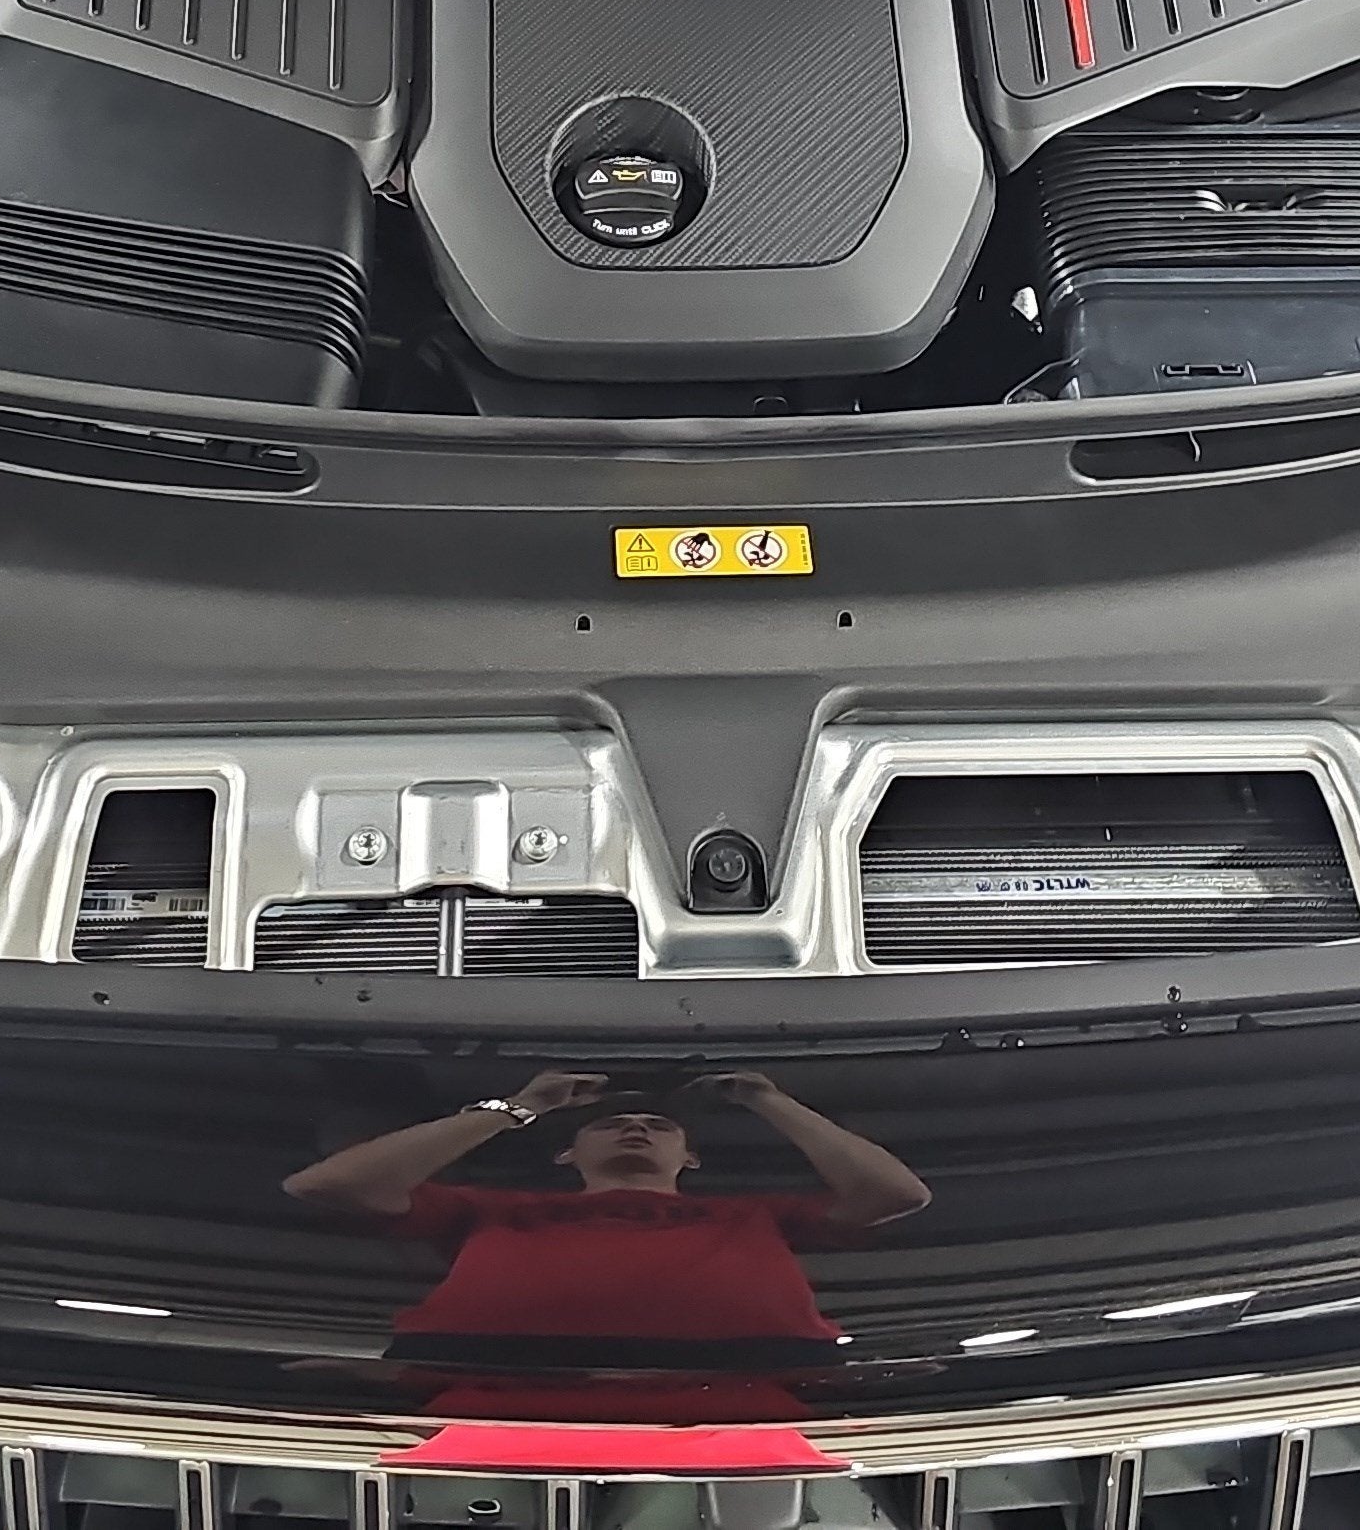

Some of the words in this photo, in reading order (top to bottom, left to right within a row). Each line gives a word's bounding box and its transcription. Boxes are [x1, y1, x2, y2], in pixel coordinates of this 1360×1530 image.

[592, 218, 613, 234] Turn
[616, 227, 638, 236] until
[641, 218, 671, 235] CLICK
